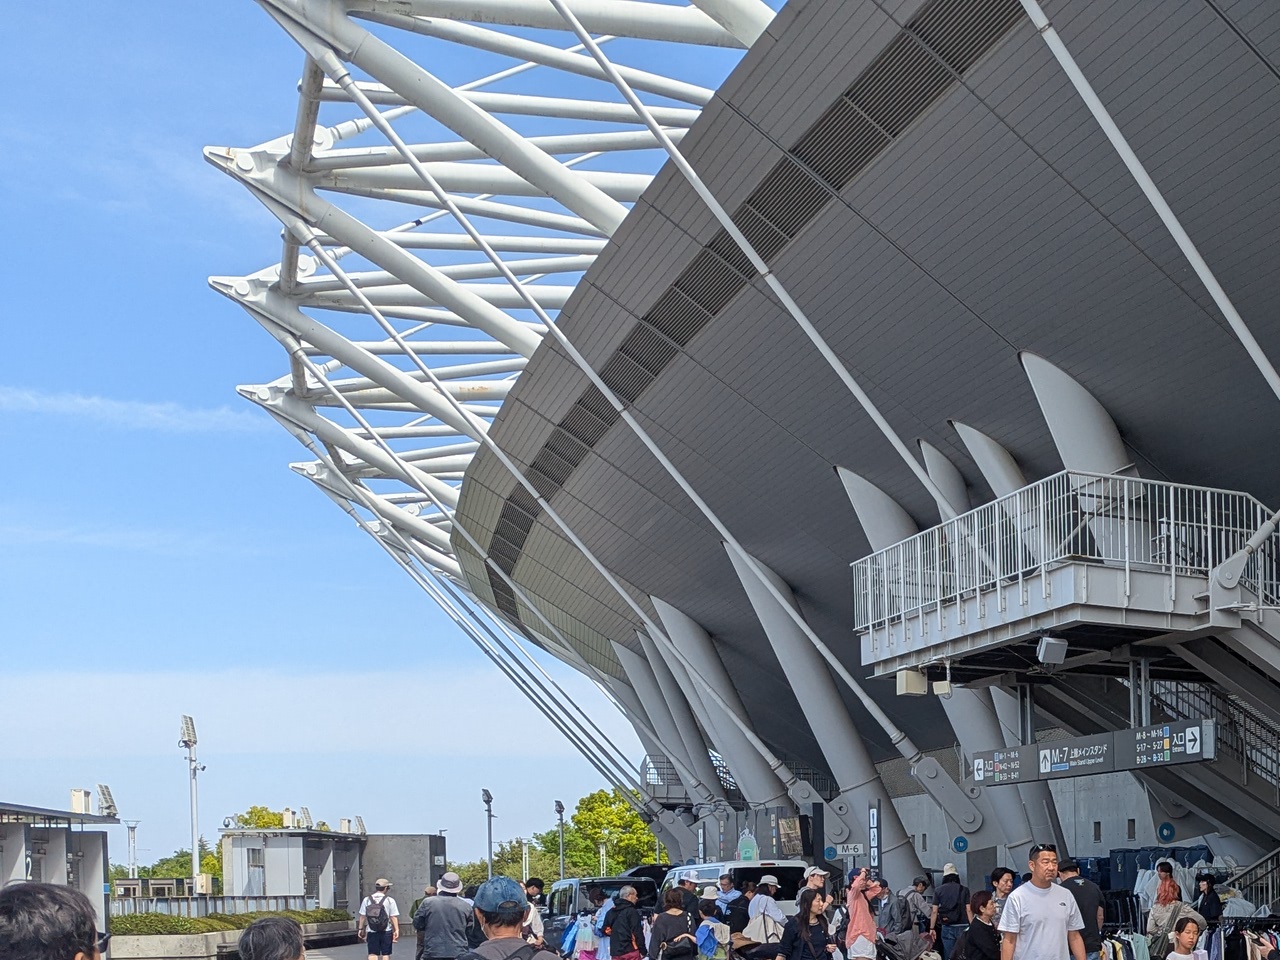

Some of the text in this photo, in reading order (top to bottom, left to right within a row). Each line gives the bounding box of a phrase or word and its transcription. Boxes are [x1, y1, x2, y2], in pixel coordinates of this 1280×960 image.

[1172, 732, 1184, 745] 入口
[1052, 747, 1068, 763] M-7
[841, 844, 859, 853] M-6
